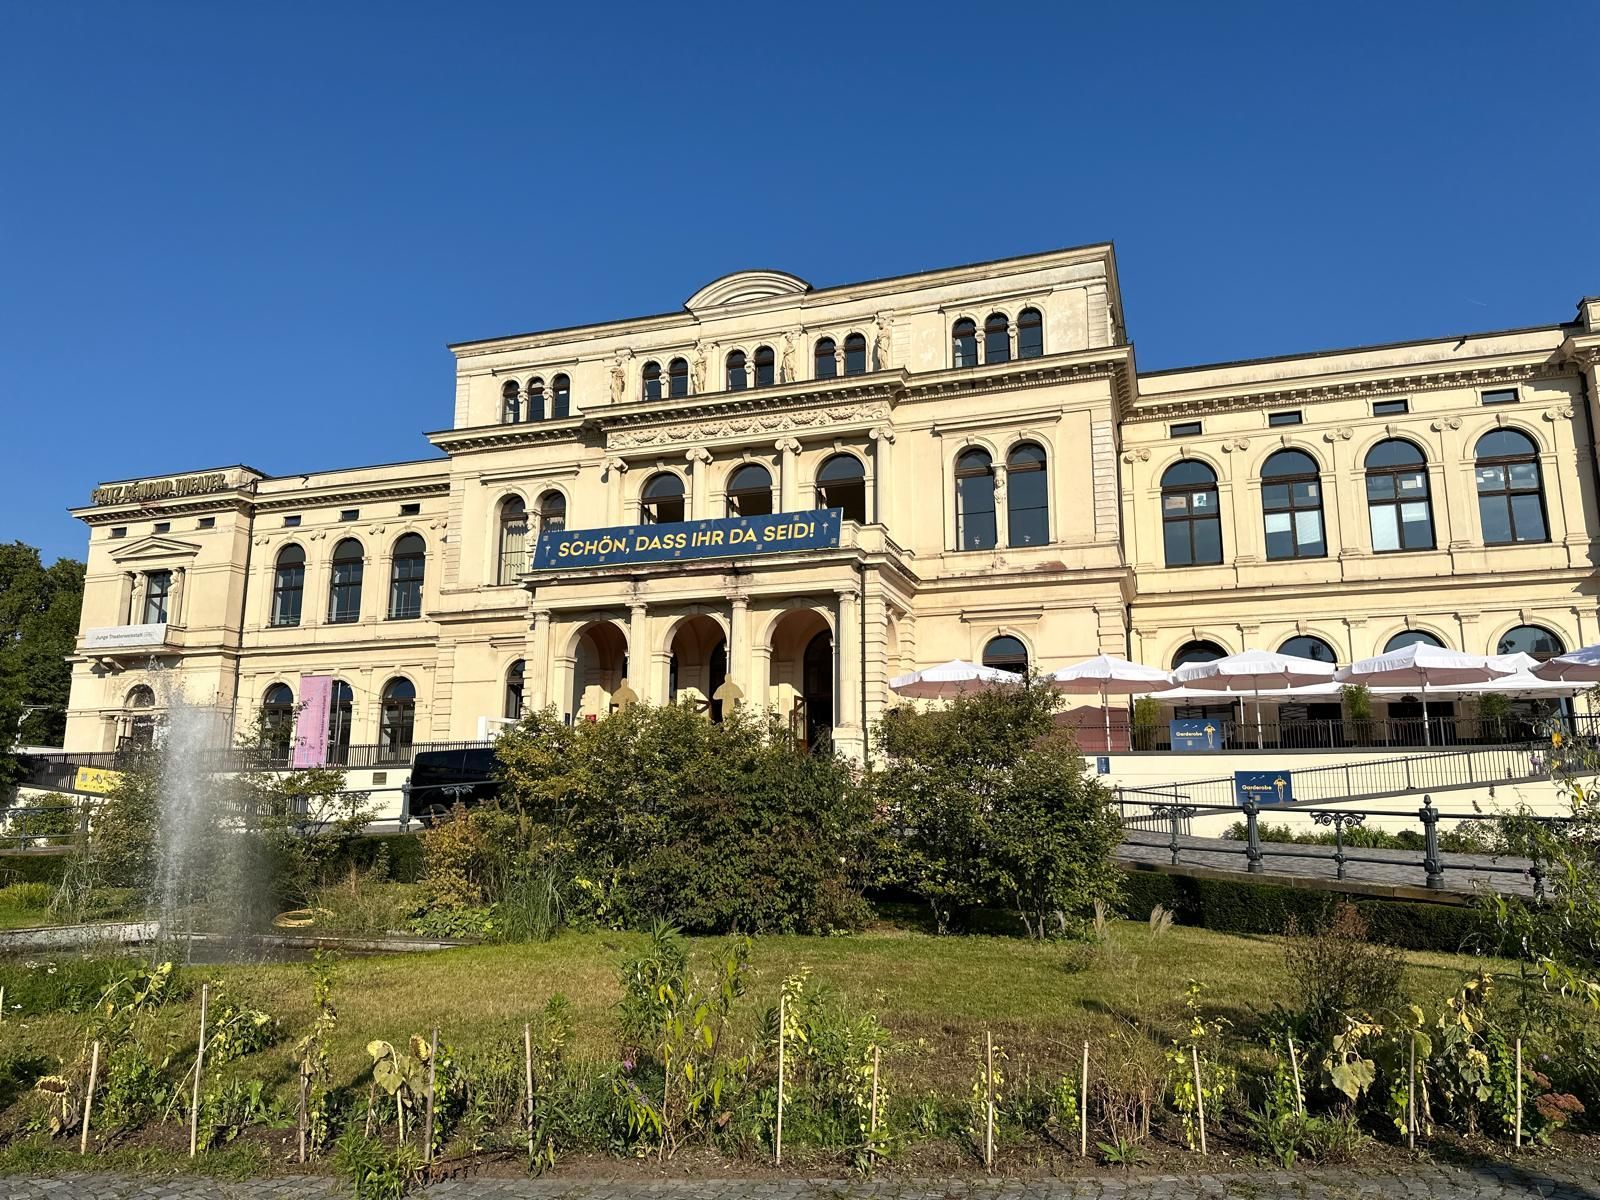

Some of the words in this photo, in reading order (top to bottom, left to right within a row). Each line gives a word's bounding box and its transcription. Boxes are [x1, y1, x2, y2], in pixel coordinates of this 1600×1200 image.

[91, 486, 123, 502] FRITZ
[176, 474, 226, 492] THEATER
[558, 535, 630, 557] SCHÖN,
[635, 532, 687, 552] DASS
[691, 528, 723, 547] IHR
[729, 526, 758, 544] DA
[763, 522, 815, 541] SEID!
